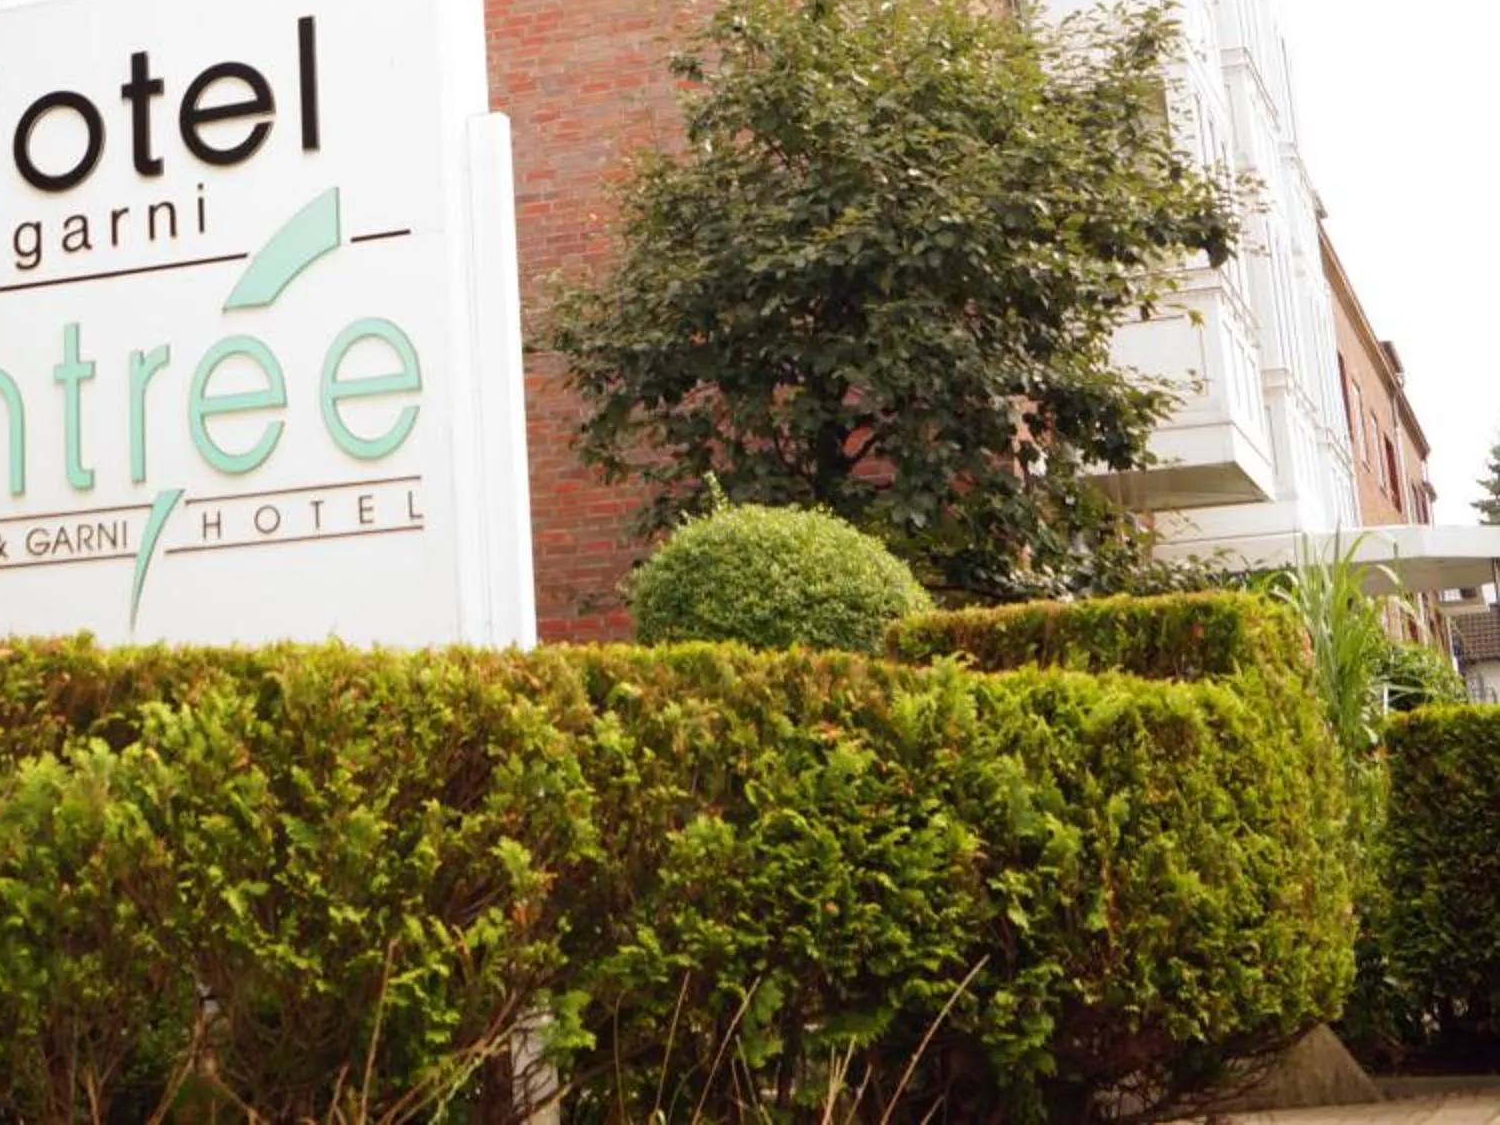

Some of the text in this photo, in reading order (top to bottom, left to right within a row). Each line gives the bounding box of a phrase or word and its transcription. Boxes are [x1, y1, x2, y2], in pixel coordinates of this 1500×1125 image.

[12, 183, 207, 271] garni
[25, 521, 128, 556] GARNI
[202, 490, 424, 540] HOTEL
